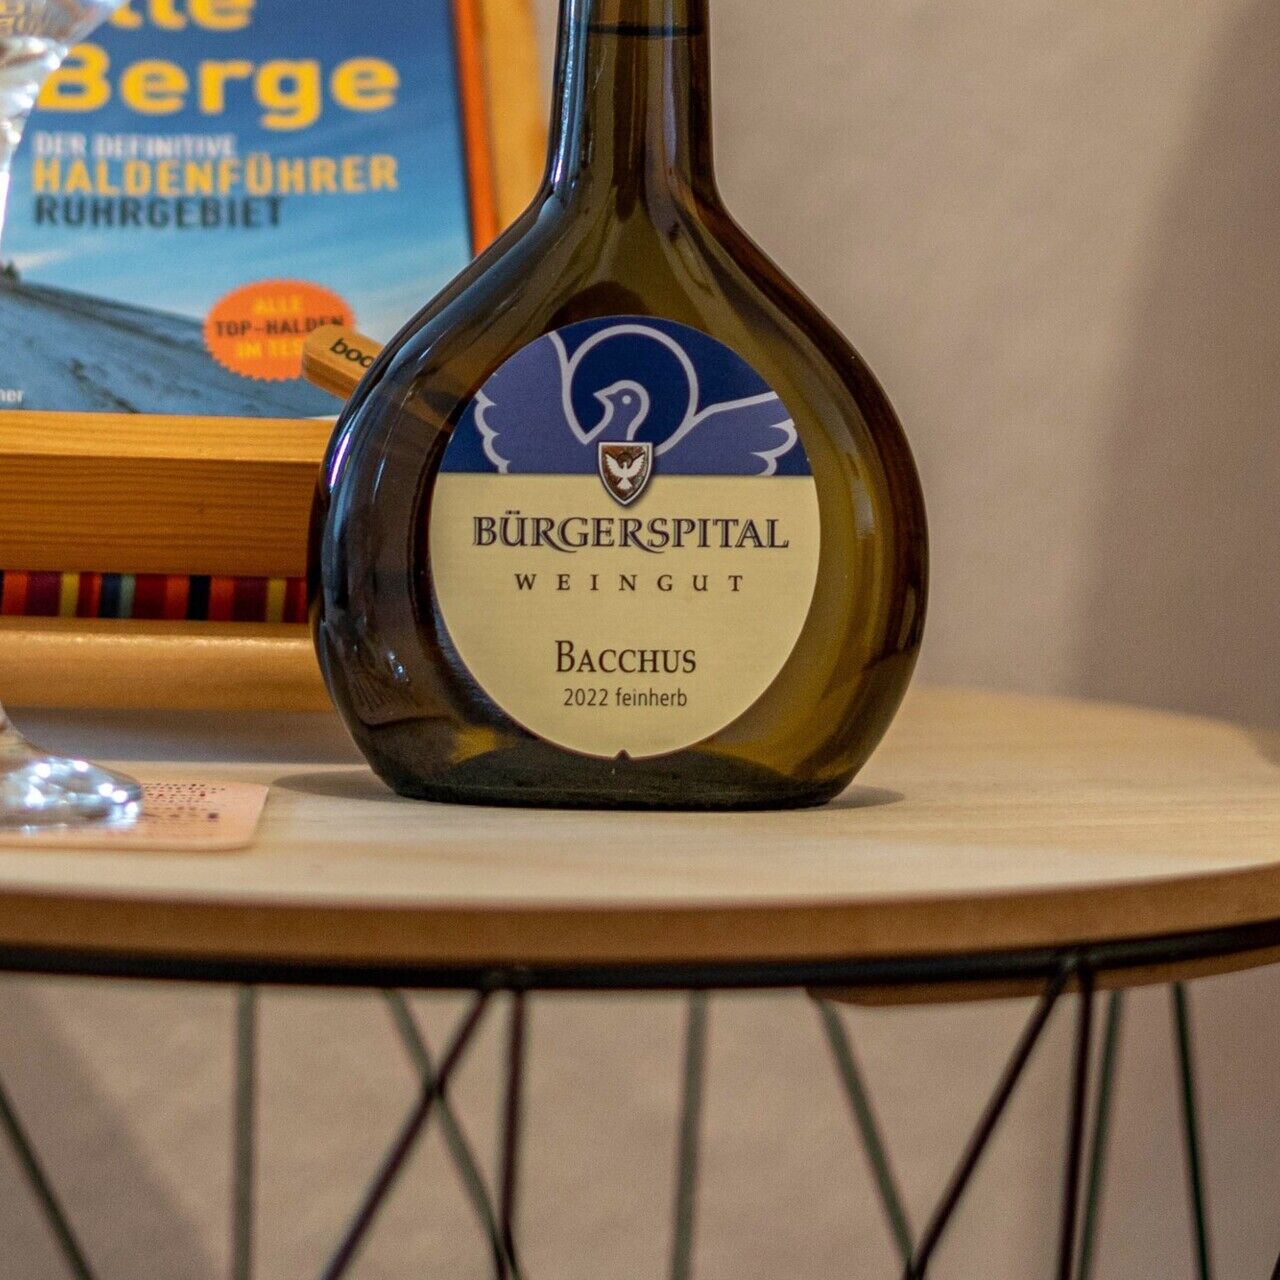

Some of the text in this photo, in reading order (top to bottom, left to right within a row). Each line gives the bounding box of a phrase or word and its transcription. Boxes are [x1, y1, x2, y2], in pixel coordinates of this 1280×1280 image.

[35, 43, 401, 131] Berge
[32, 131, 87, 157] DER
[32, 152, 399, 197] HALDENFÜHRER
[34, 195, 282, 229] RUHRGEBIET
[472, 509, 790, 554] BÜRGERSPITAL
[514, 572, 744, 592] WEINGUT
[563, 687, 688, 707] 2022 feinherb
